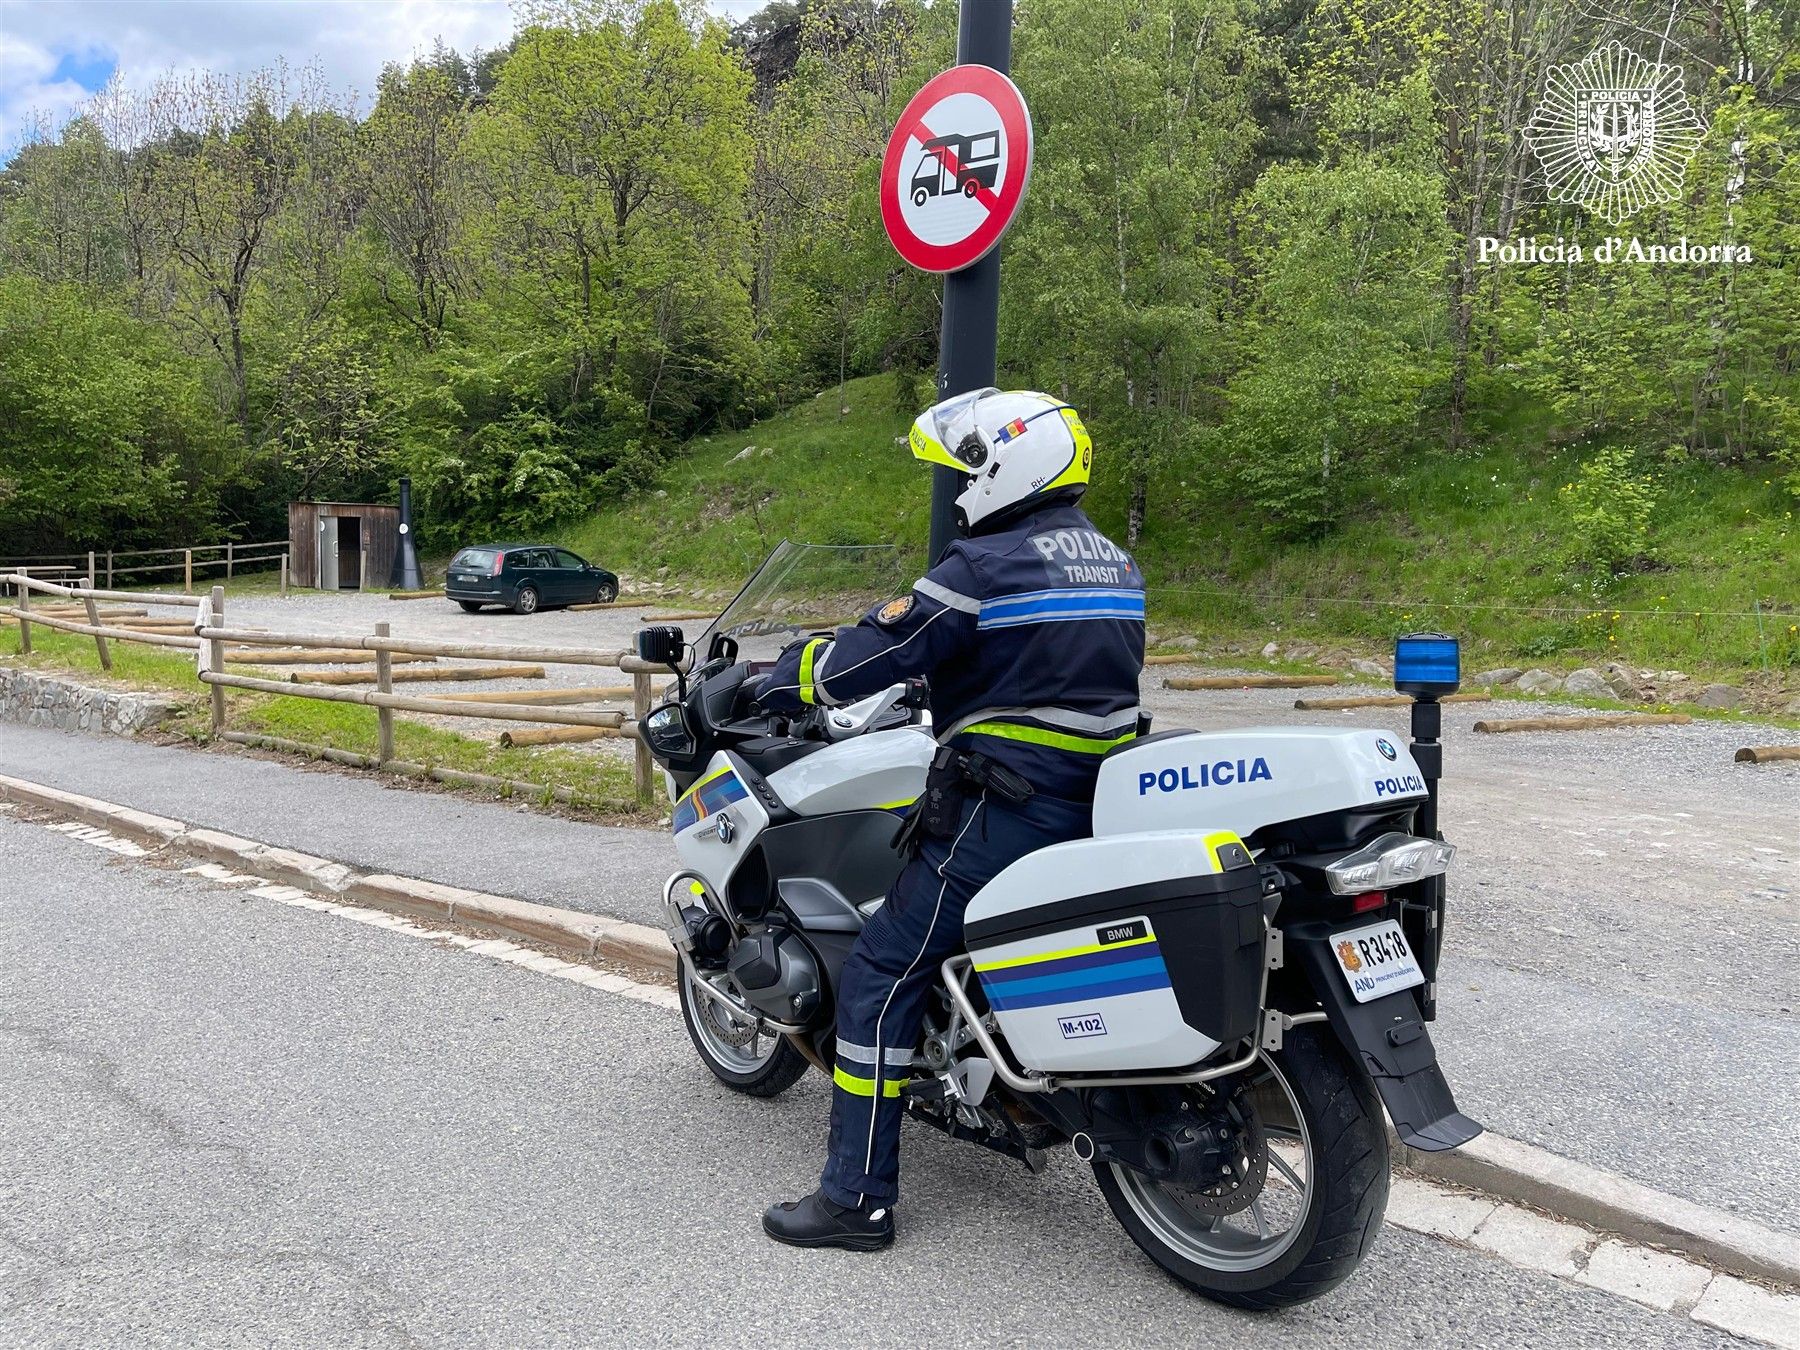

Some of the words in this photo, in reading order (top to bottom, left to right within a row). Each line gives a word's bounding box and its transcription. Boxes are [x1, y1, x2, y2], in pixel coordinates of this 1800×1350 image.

[1063, 560, 1119, 584] TRÀNSIT
[1139, 757, 1273, 795] POLICIA
[1374, 775, 1424, 796] POLICIA
[1107, 926, 1133, 941] BMW
[1357, 930, 1407, 967] R3418
[1355, 977, 1375, 993] AND
[1062, 1018, 1102, 1034] M-102
